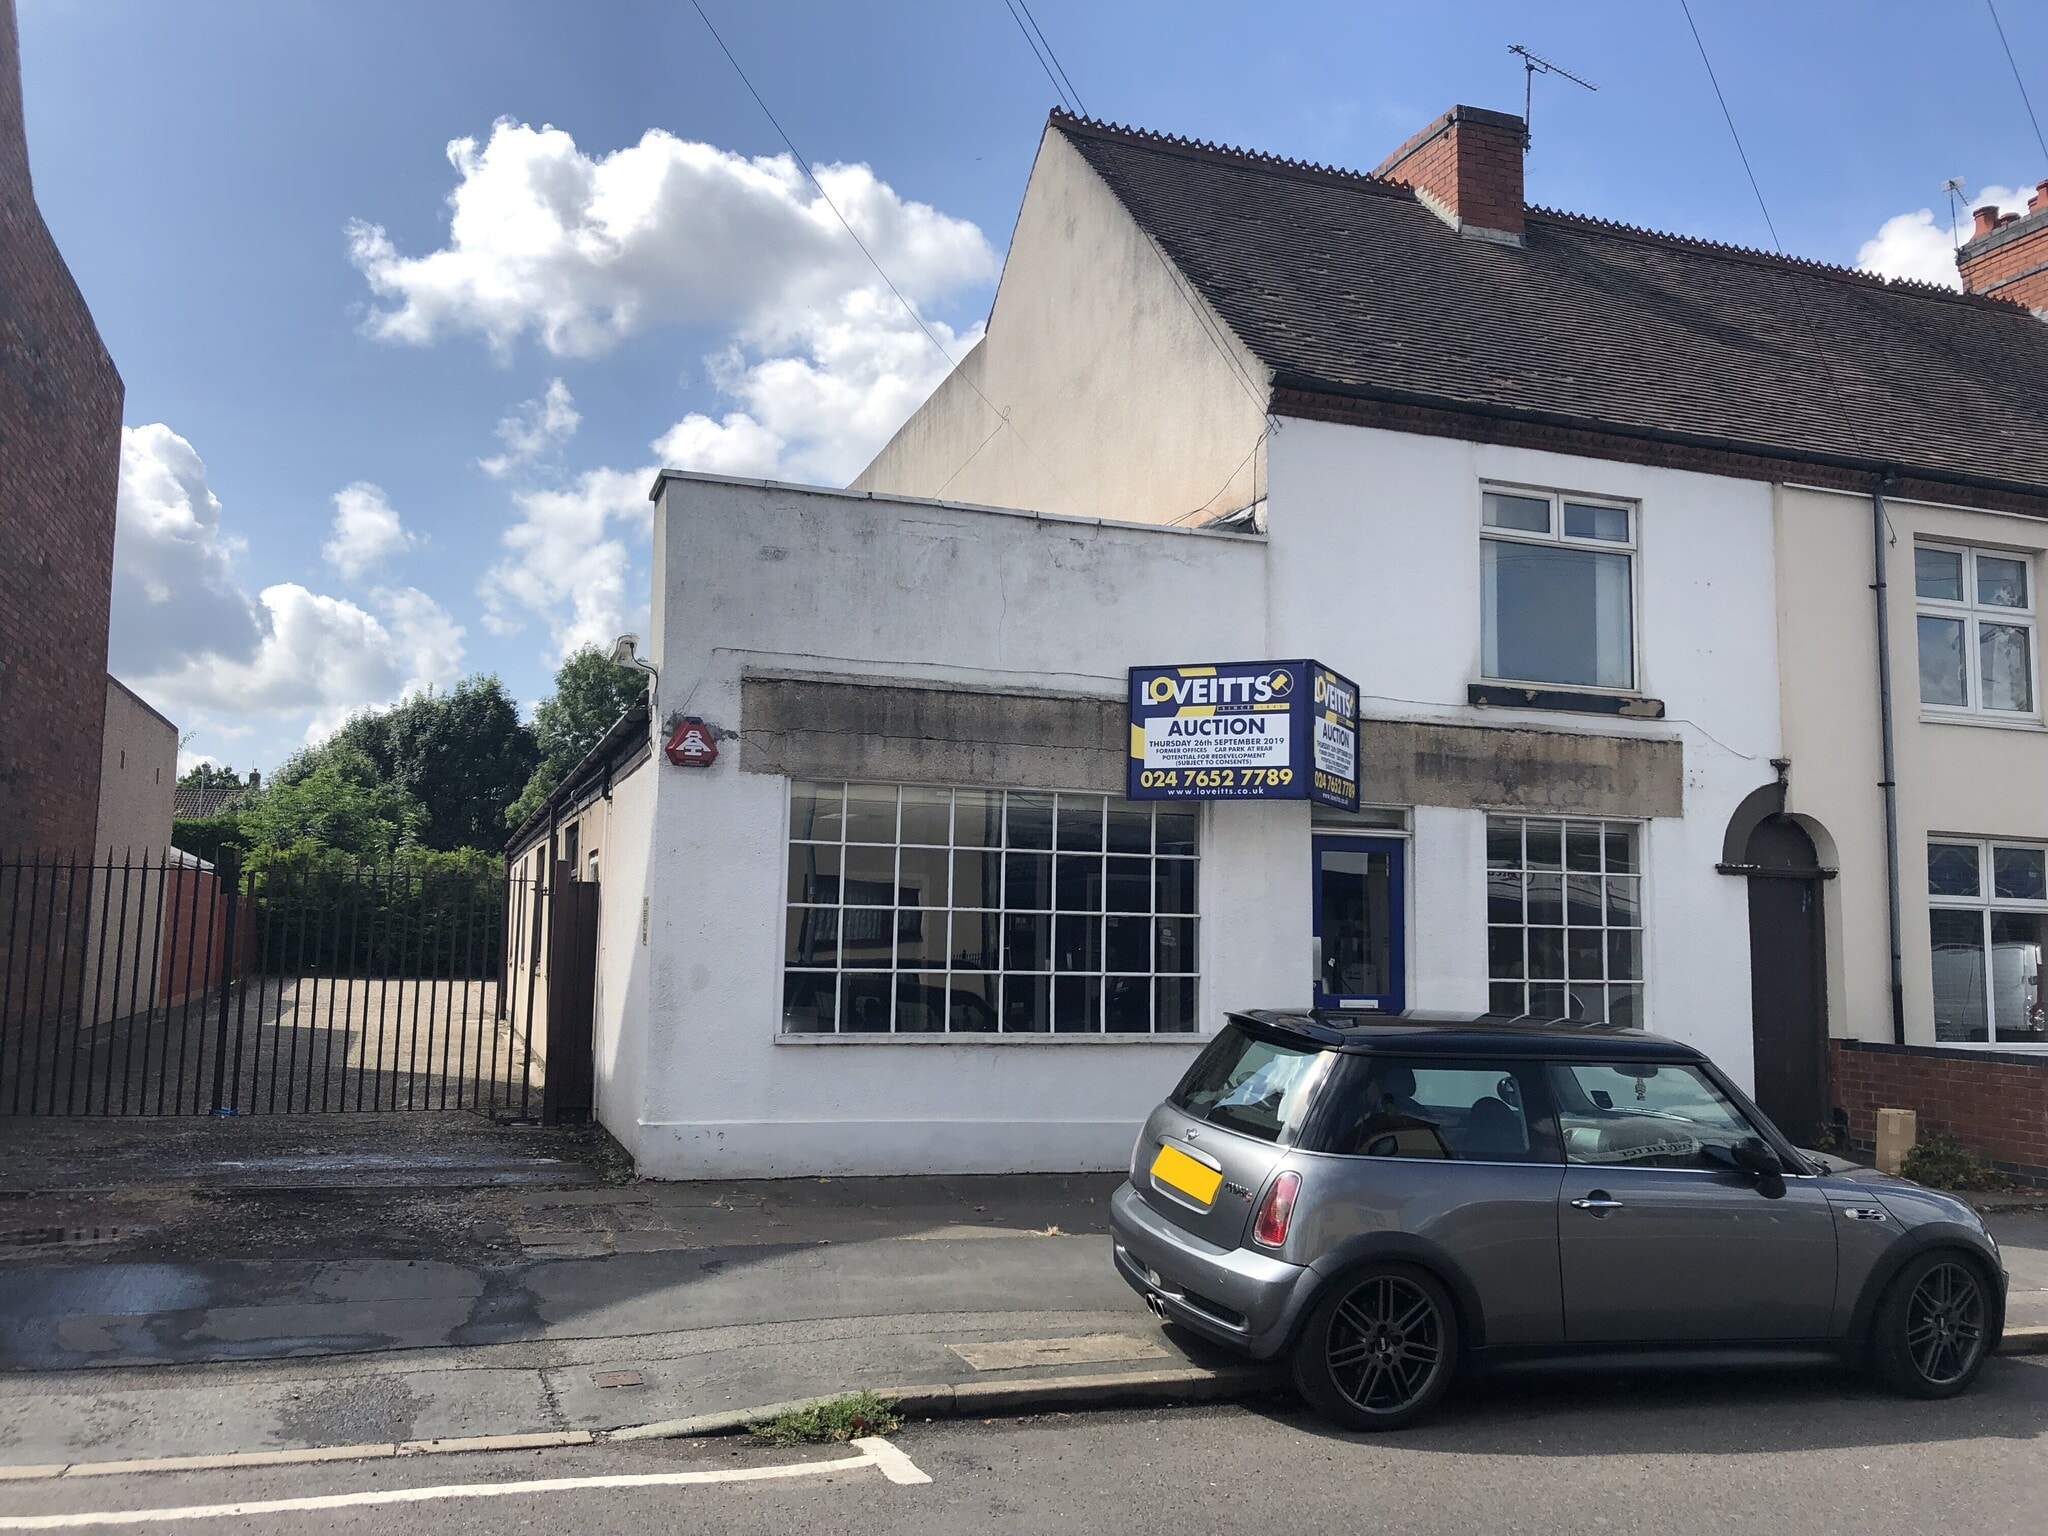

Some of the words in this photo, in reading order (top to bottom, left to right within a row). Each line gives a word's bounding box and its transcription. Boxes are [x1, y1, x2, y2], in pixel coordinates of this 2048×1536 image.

[1141, 675, 1273, 706] LOVEITTS
[1314, 675, 1351, 718] LOVEITTS
[1167, 718, 1265, 737] AUCTION
[1322, 722, 1350, 749] AUCTION
[1149, 740, 1192, 748] THURSDAY
[1194, 739, 1213, 747] 26th
[1214, 738, 1261, 746] SEPTEMBER
[1263, 737, 1285, 745] 2019
[1140, 770, 1178, 788] 024
[1183, 769, 1234, 787] 7652
[1240, 768, 1293, 786] 7789
[1314, 770, 1327, 790] 024
[1327, 775, 1342, 795] 7652
[1167, 786, 1264, 796] www.loveitts.co.uk
